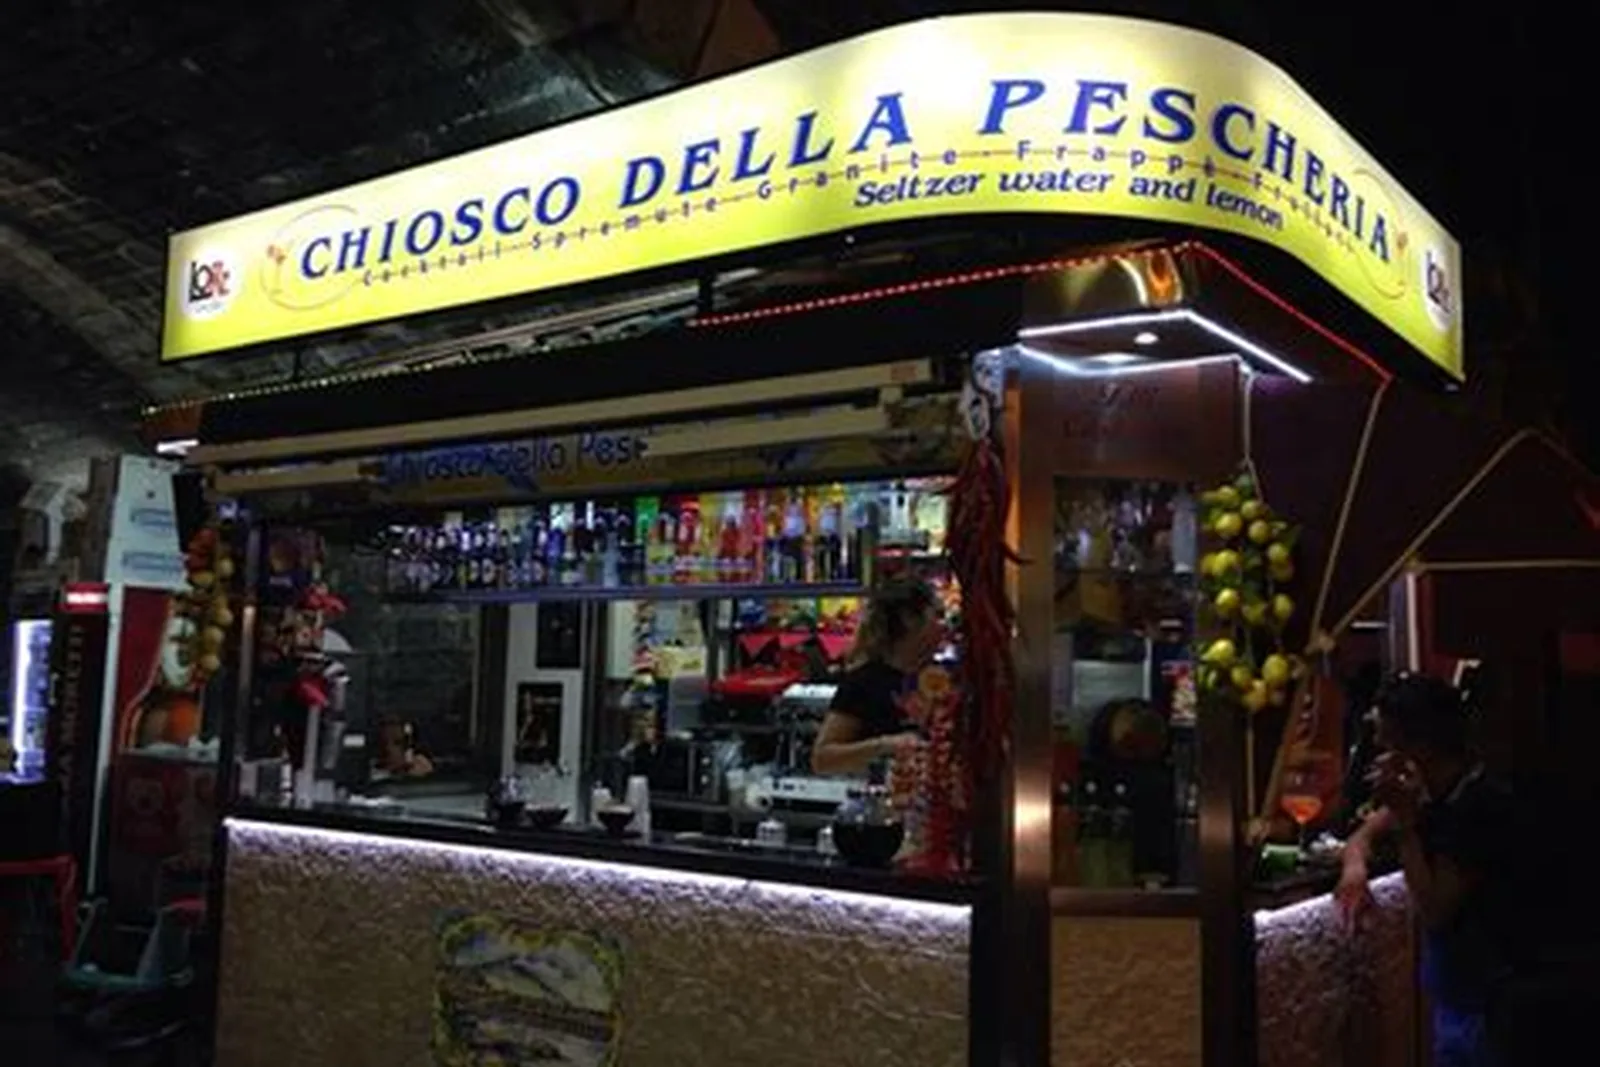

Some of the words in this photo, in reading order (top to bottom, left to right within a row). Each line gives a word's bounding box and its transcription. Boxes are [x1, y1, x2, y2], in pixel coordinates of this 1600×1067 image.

[301, 176, 581, 279] CHIOSCO
[618, 92, 913, 209] DELLA
[977, 79, 1391, 264] PESCHERIA
[531, 196, 719, 251] Spremute
[756, 147, 958, 200] Granite
[853, 173, 985, 208] Seltzer
[998, 167, 1114, 193] water
[1128, 176, 1197, 203] and
[1206, 182, 1284, 232] lemon
